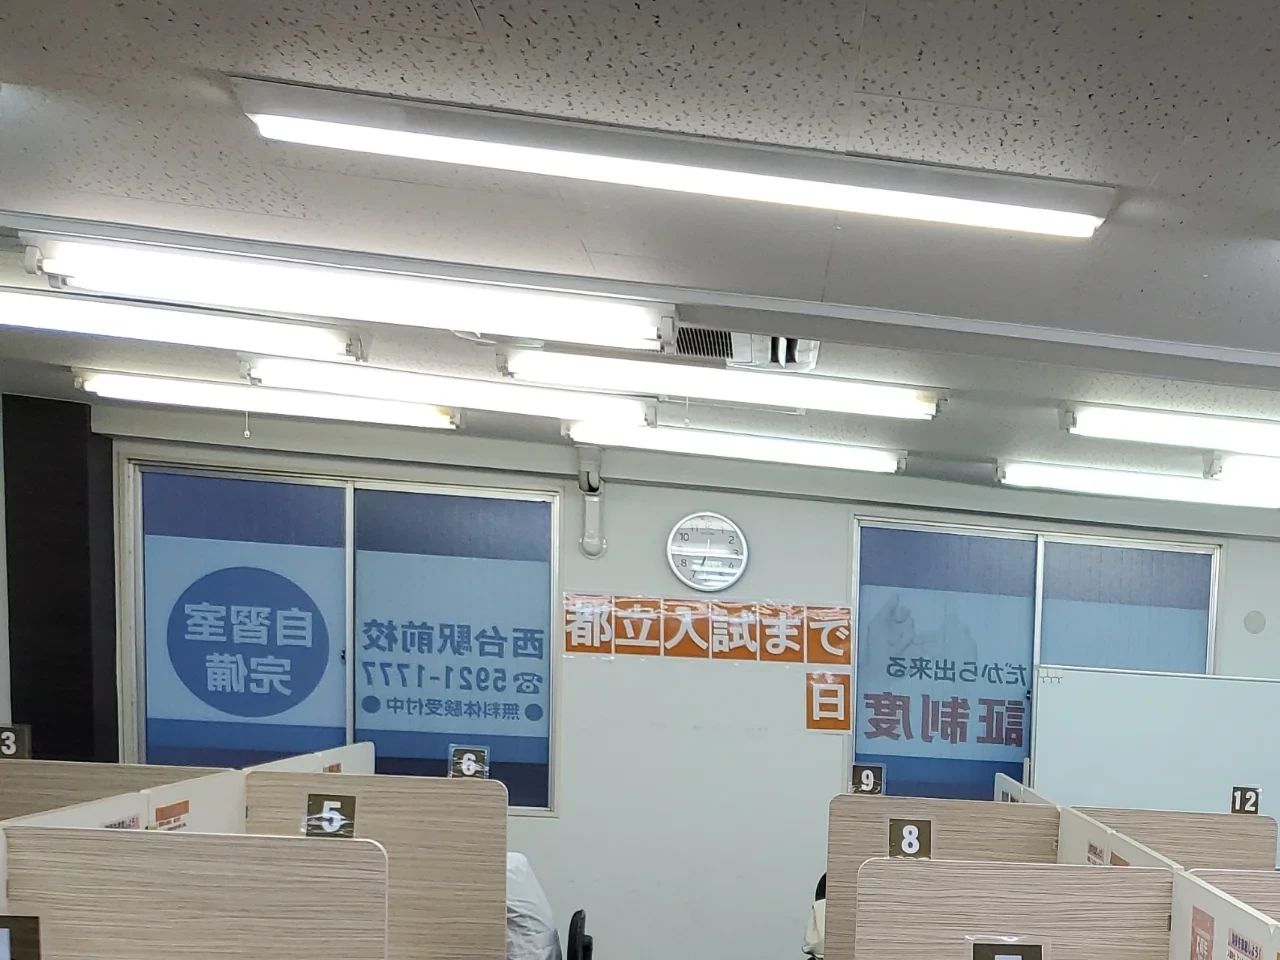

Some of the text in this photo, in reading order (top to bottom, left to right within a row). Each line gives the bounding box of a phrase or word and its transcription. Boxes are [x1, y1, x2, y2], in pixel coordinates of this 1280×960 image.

[680, 532, 689, 541] 10
[565, 603, 850, 657] 都立入試まで
[811, 683, 845, 722] 日
[0, 730, 16, 755] 3
[460, 753, 478, 776] 6
[861, 769, 875, 792] 9
[1233, 790, 1256, 812] 12
[322, 800, 342, 832] 5
[901, 824, 920, 855] 8
